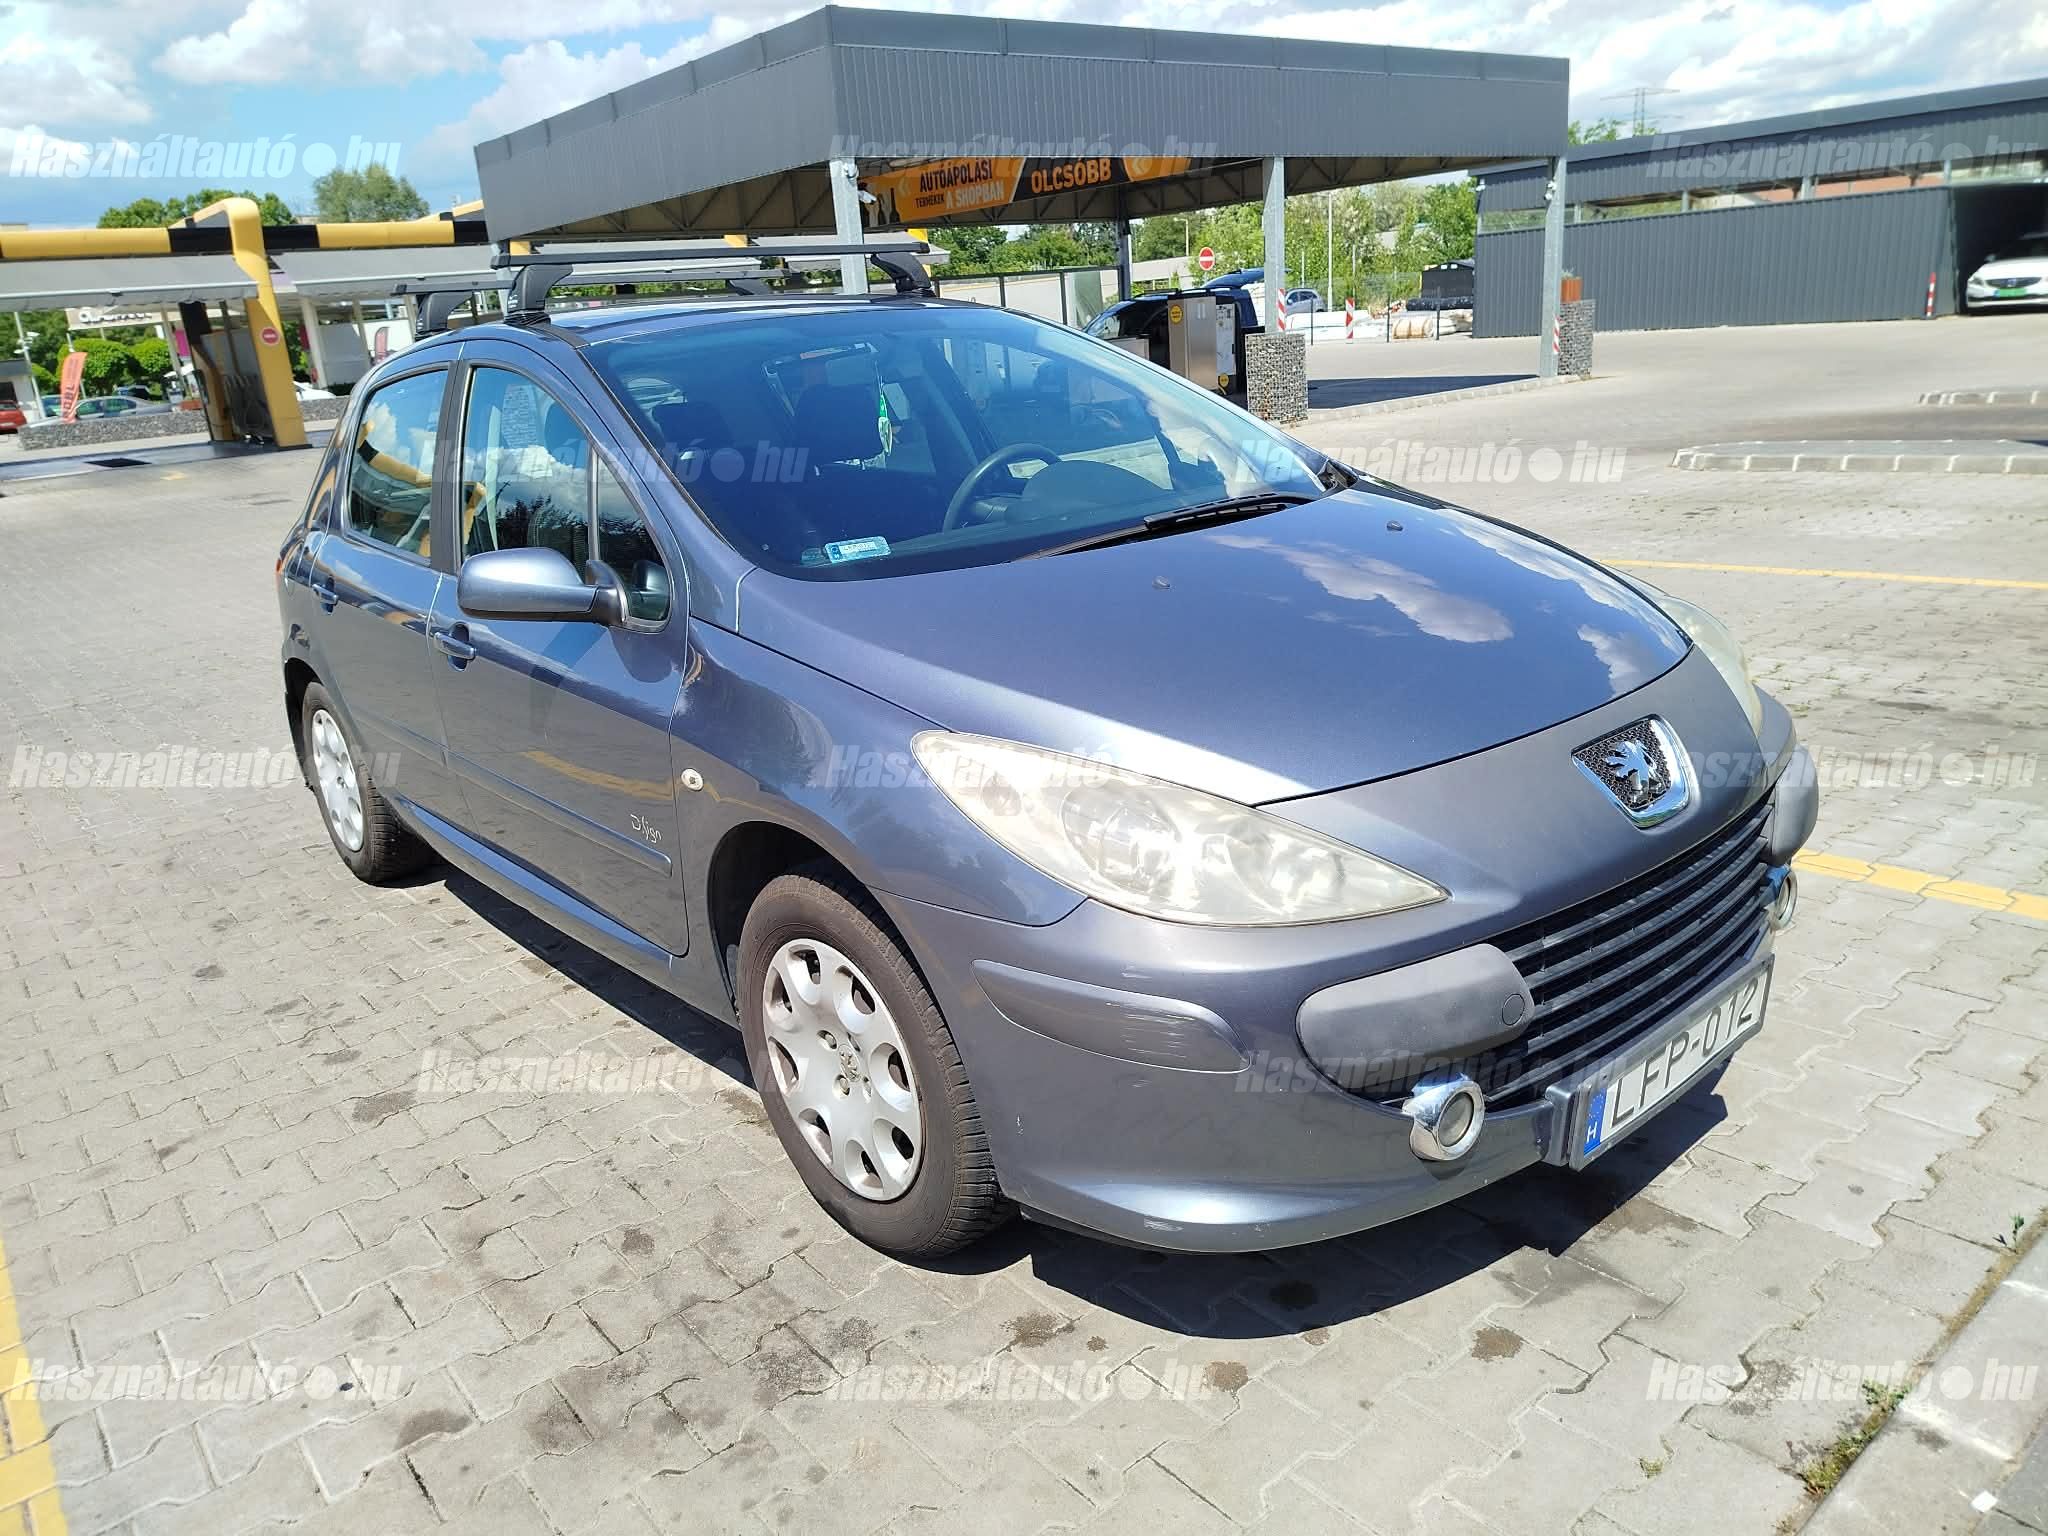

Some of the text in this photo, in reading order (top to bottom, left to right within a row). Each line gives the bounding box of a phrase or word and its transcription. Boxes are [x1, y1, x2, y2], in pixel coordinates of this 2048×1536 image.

[946, 190, 953, 208] A
[956, 180, 1004, 207] SHOPBAN
[1031, 157, 1111, 194] OLCSÓBB
[1611, 978, 1759, 1128] LFP-012
